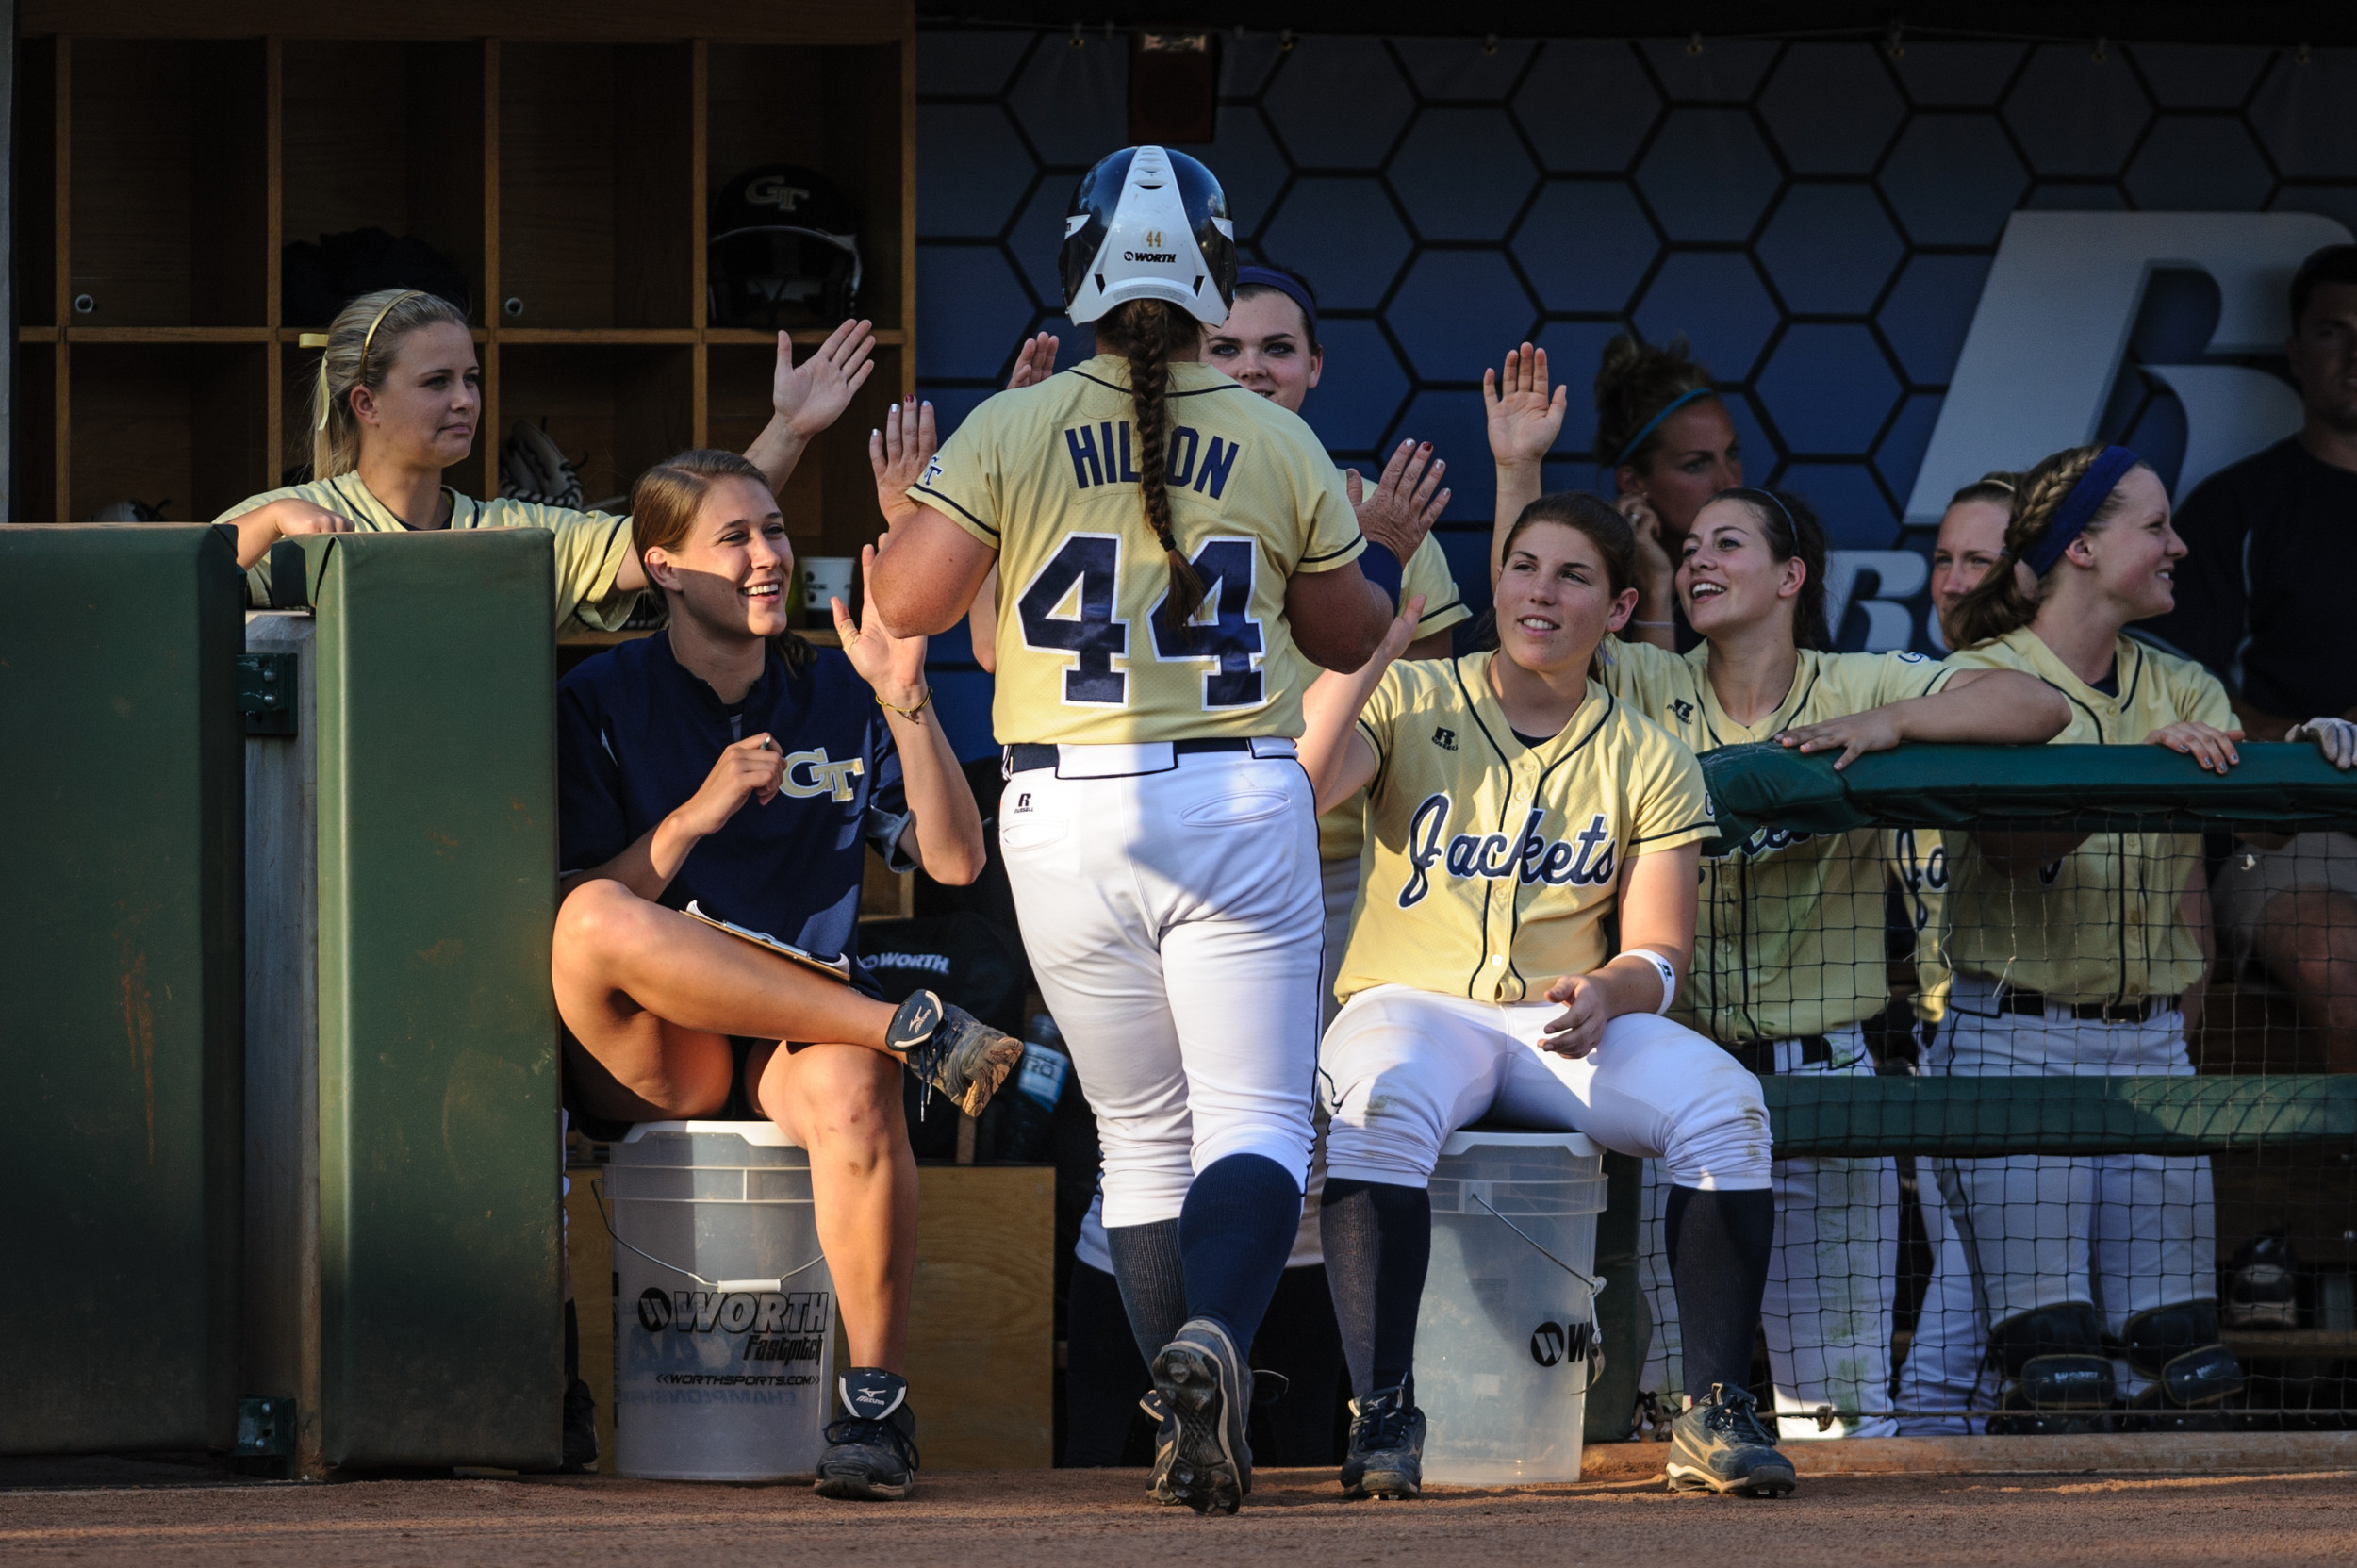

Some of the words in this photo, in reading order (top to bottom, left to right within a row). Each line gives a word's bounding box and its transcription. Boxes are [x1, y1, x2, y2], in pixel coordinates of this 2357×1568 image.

[745, 176, 809, 211] GT
[1135, 253, 1177, 263] WORTH
[1146, 231, 1161, 248] 44
[1064, 421, 1240, 500] HILON
[1014, 531, 1267, 711] 44
[779, 747, 865, 802] GT
[1397, 793, 1616, 908] Jackets
[879, 951, 950, 975] WORTH
[674, 1291, 830, 1334] WORTH
[743, 1333, 823, 1366] Fastpitch
